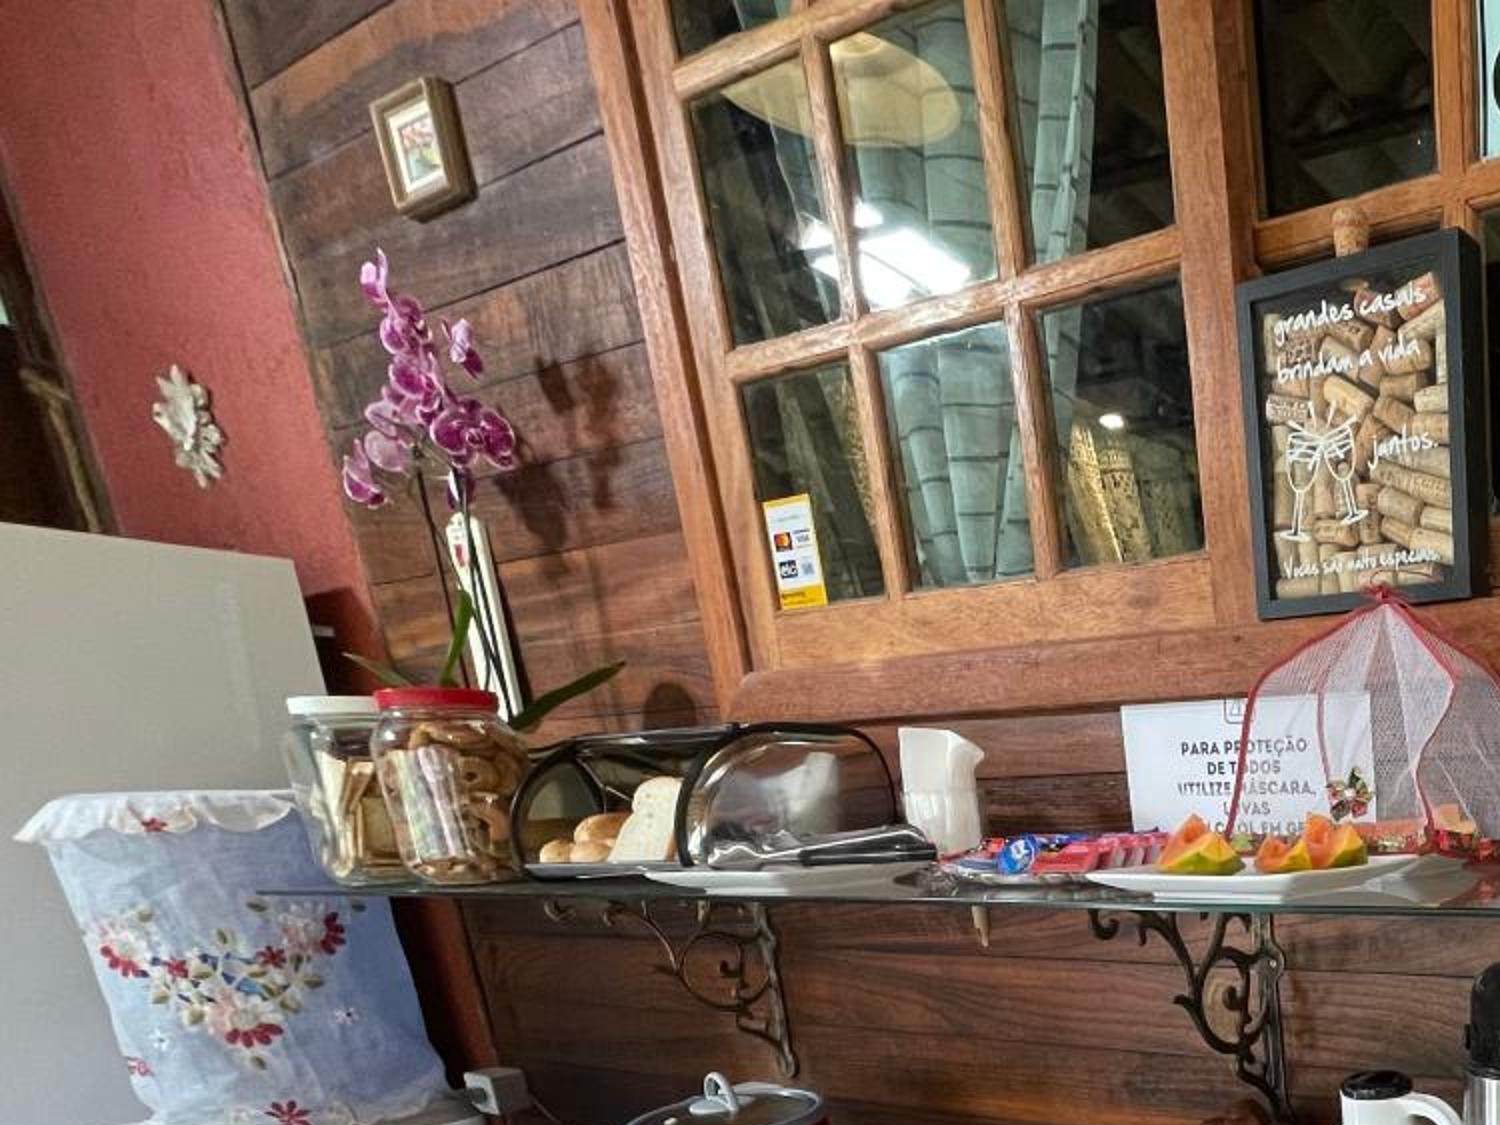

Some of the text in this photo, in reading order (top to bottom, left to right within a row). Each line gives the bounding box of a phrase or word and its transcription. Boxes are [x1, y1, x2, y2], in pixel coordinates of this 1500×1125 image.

[1273, 299, 1354, 347] grandes
[1358, 348, 1373, 367] a
[1378, 333, 1421, 363] vida
[1180, 741, 1220, 756] PARA
[1207, 760, 1226, 775] DE
[1178, 780, 1232, 797] UTILIZE
[1223, 801, 1272, 816] LVAS
